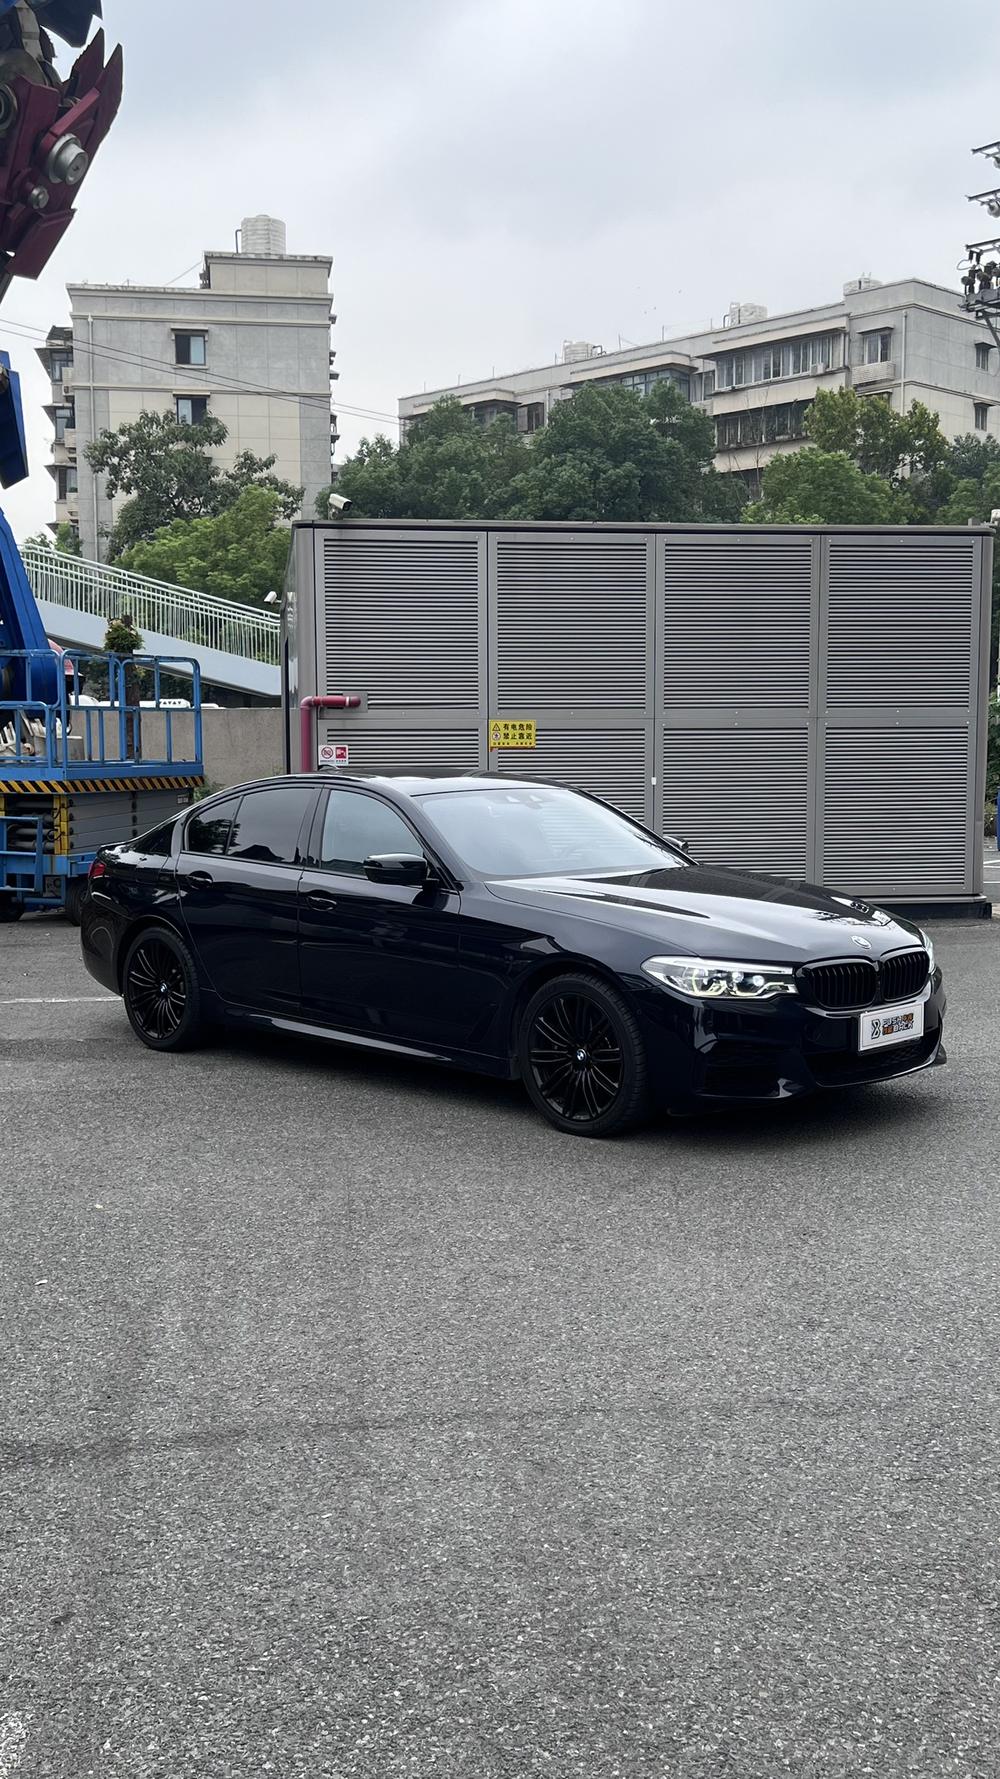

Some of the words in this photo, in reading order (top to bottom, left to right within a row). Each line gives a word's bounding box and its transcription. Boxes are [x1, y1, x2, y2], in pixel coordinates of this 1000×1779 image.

[503, 723, 533, 731] 有电危险
[503, 732, 533, 740] 禁止靠近
